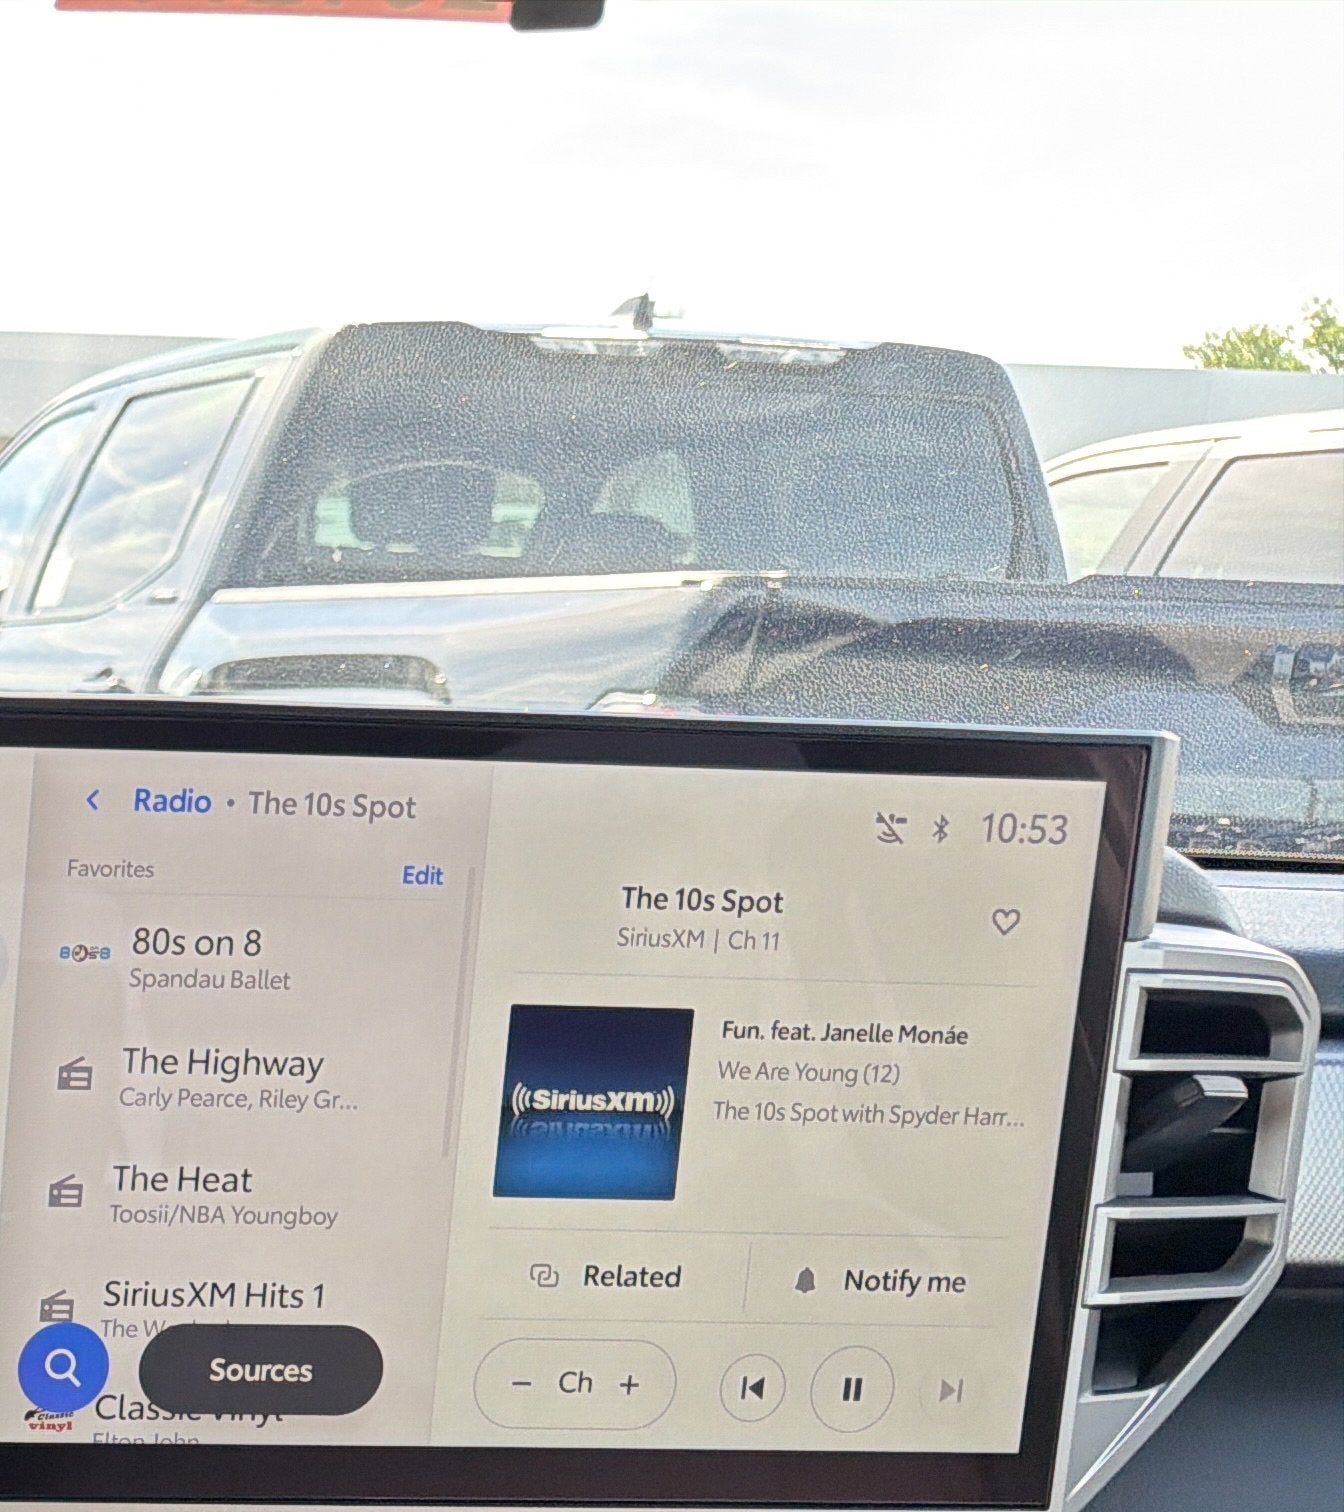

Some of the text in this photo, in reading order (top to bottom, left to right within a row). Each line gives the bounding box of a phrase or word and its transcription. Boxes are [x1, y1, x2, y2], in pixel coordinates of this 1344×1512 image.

[134, 788, 416, 824] Radio The 10s Spot
[981, 812, 1069, 846] 10:53
[67, 859, 155, 879] Favorites
[402, 865, 444, 887] Edit
[621, 885, 784, 918] The 10s Spot
[132, 928, 262, 957] 80s on 8
[617, 926, 705, 950] SiriusXM
[728, 928, 758, 952] Ch
[762, 930, 781, 952] 11
[129, 969, 291, 994] Spandau Ballet
[721, 1020, 969, 1046] Fun. feat. Janelle Monáe
[123, 1048, 324, 1082] The Highway
[718, 1061, 901, 1087] We Are Young (12)
[119, 1088, 172, 1110] Carly
[179, 1089, 252, 1110] Pearce,
[259, 1089, 308, 1112] Riley
[714, 1101, 749, 1122] The
[754, 1103, 786, 1123] 10s
[790, 1103, 839, 1127] Spot
[841, 1104, 884, 1124] with
[888, 1105, 959, 1129] Spyder
[113, 1165, 253, 1193] The Heat
[110, 1205, 338, 1230] Toosii/NBA Youngboy
[583, 1264, 682, 1290] Related
[844, 1269, 967, 1297] Notify me
[103, 1281, 325, 1309] SiriusXM Hits 1
[101, 1319, 139, 1338] The
[209, 1358, 314, 1383] Sources
[559, 1371, 593, 1395] Ch
